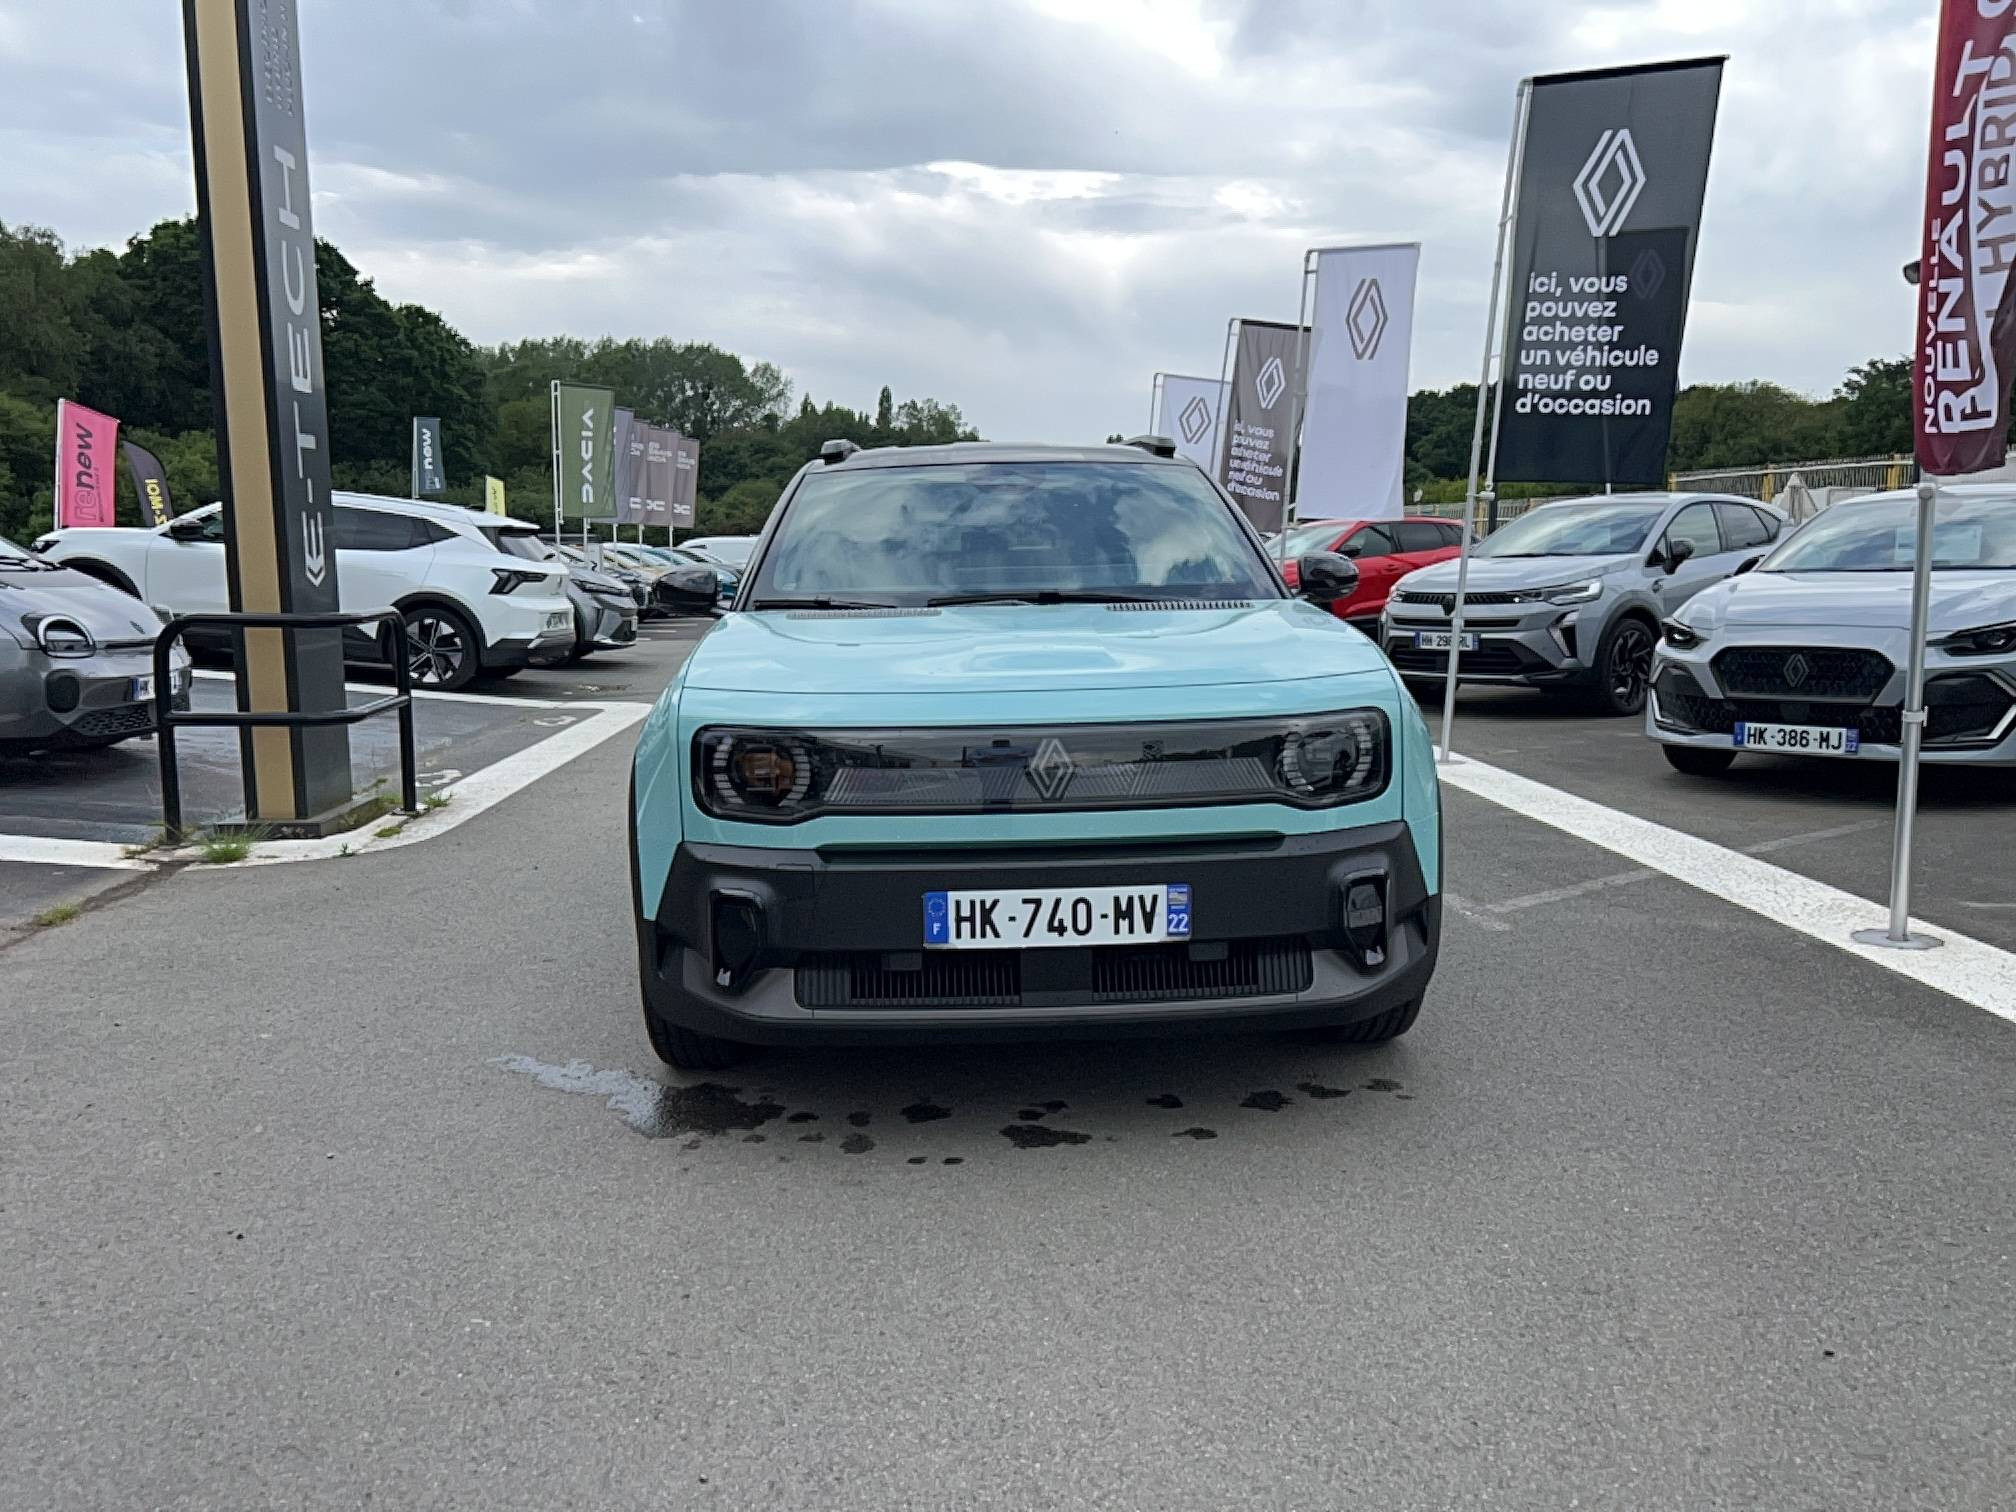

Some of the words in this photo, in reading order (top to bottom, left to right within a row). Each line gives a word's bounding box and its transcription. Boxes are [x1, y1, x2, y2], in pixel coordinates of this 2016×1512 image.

[1937, 39, 1996, 434] RENAULT
[1528, 271, 1562, 297] ici,
[1569, 274, 1628, 293] vous
[1525, 300, 1617, 323] pouvez
[1522, 320, 1624, 342] acheter
[1924, 217, 1942, 434] NOUVELLE
[273, 145, 326, 588] E-TECH
[1520, 348, 1551, 366] un
[1555, 344, 1660, 367] véhicule
[1517, 369, 1577, 391] neuf
[1578, 374, 1612, 391] ou
[1247, 424, 1275, 438] vous
[74, 422, 96, 521] renew
[1746, 726, 1843, 751] HK-386-MJ
[954, 893, 1159, 940] HK-740-MV
[1168, 912, 1189, 933] 22
[932, 922, 941, 936] F
